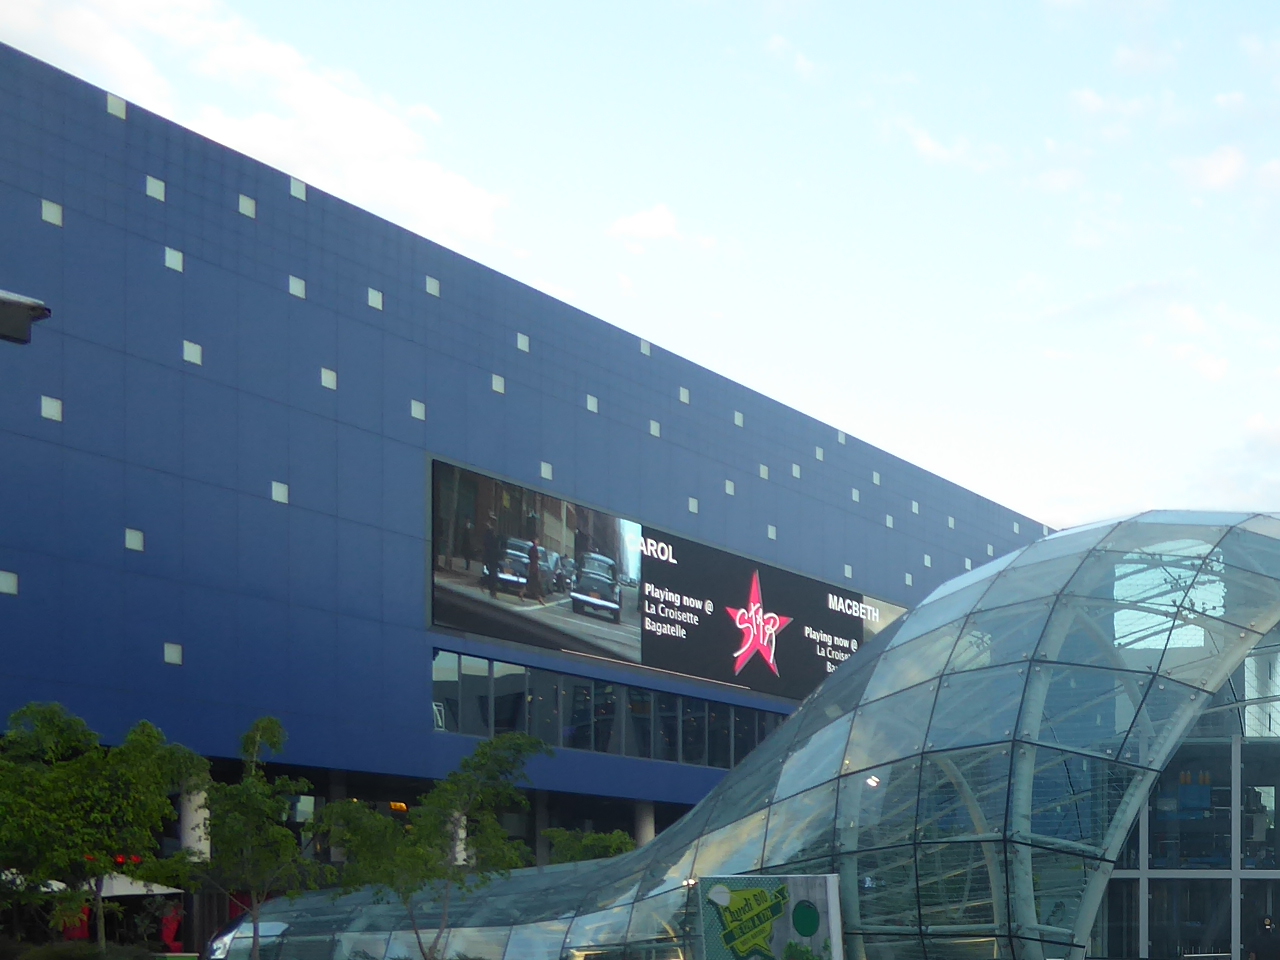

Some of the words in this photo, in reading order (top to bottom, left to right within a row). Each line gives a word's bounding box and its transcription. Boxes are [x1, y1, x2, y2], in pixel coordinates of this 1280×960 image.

[625, 533, 678, 564] CAROL
[644, 582, 681, 606] Playing
[682, 594, 704, 610] now
[704, 600, 714, 615] @
[644, 600, 657, 615] La
[658, 603, 700, 626] Croisette
[827, 593, 880, 622] MACBETH
[644, 616, 687, 639] Bagatelle
[733, 602, 780, 664] STAR
[804, 626, 832, 646] Playing
[833, 635, 850, 648] now
[850, 639, 858, 653] @
[816, 644, 826, 657] La
[826, 646, 851, 662] Croise
[724, 897, 754, 923] Lundi
[752, 890, 768, 907] BIO
